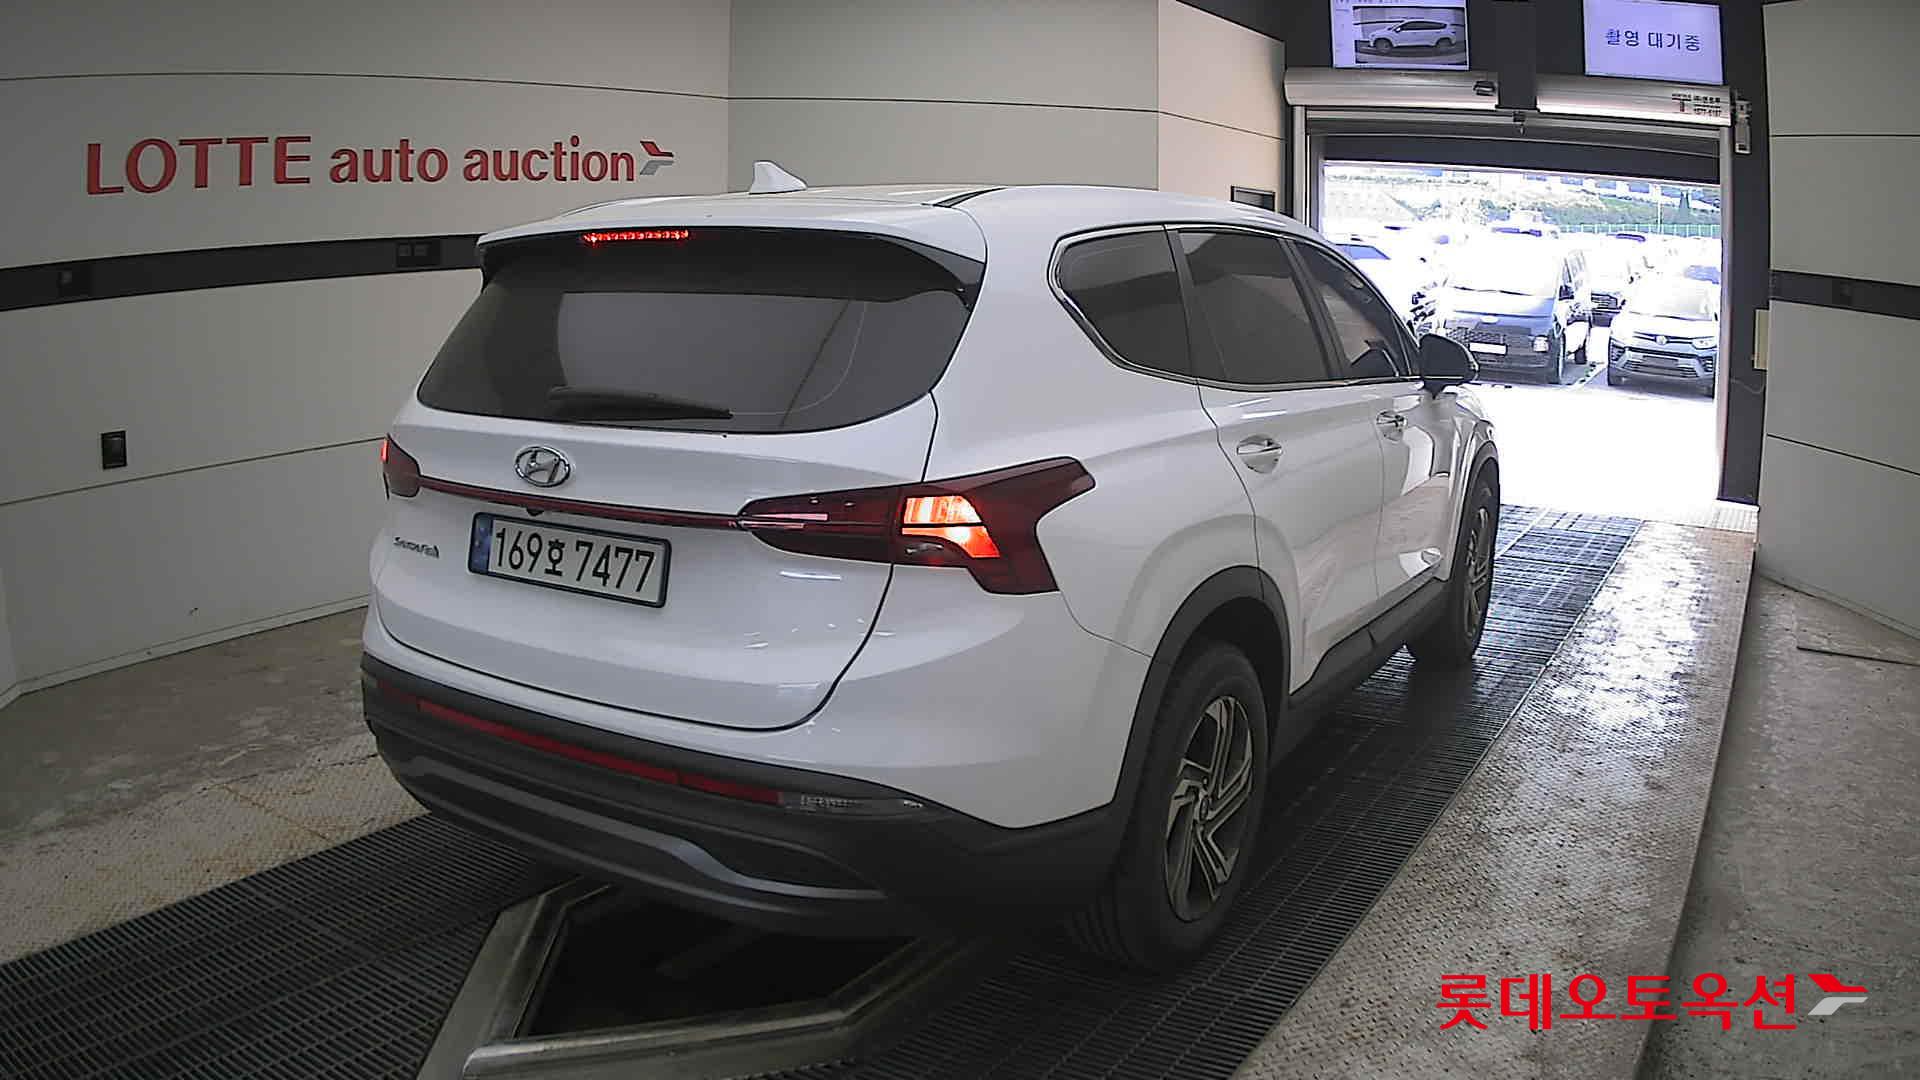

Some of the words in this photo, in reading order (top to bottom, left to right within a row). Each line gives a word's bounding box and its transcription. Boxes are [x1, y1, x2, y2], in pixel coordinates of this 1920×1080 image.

[1648, 31, 1700, 52] 대기중
[86, 135, 312, 195] LOTTE
[329, 138, 449, 184] auto
[463, 135, 635, 182] auction
[495, 527, 565, 577] 169호
[575, 539, 655, 593] 7477
